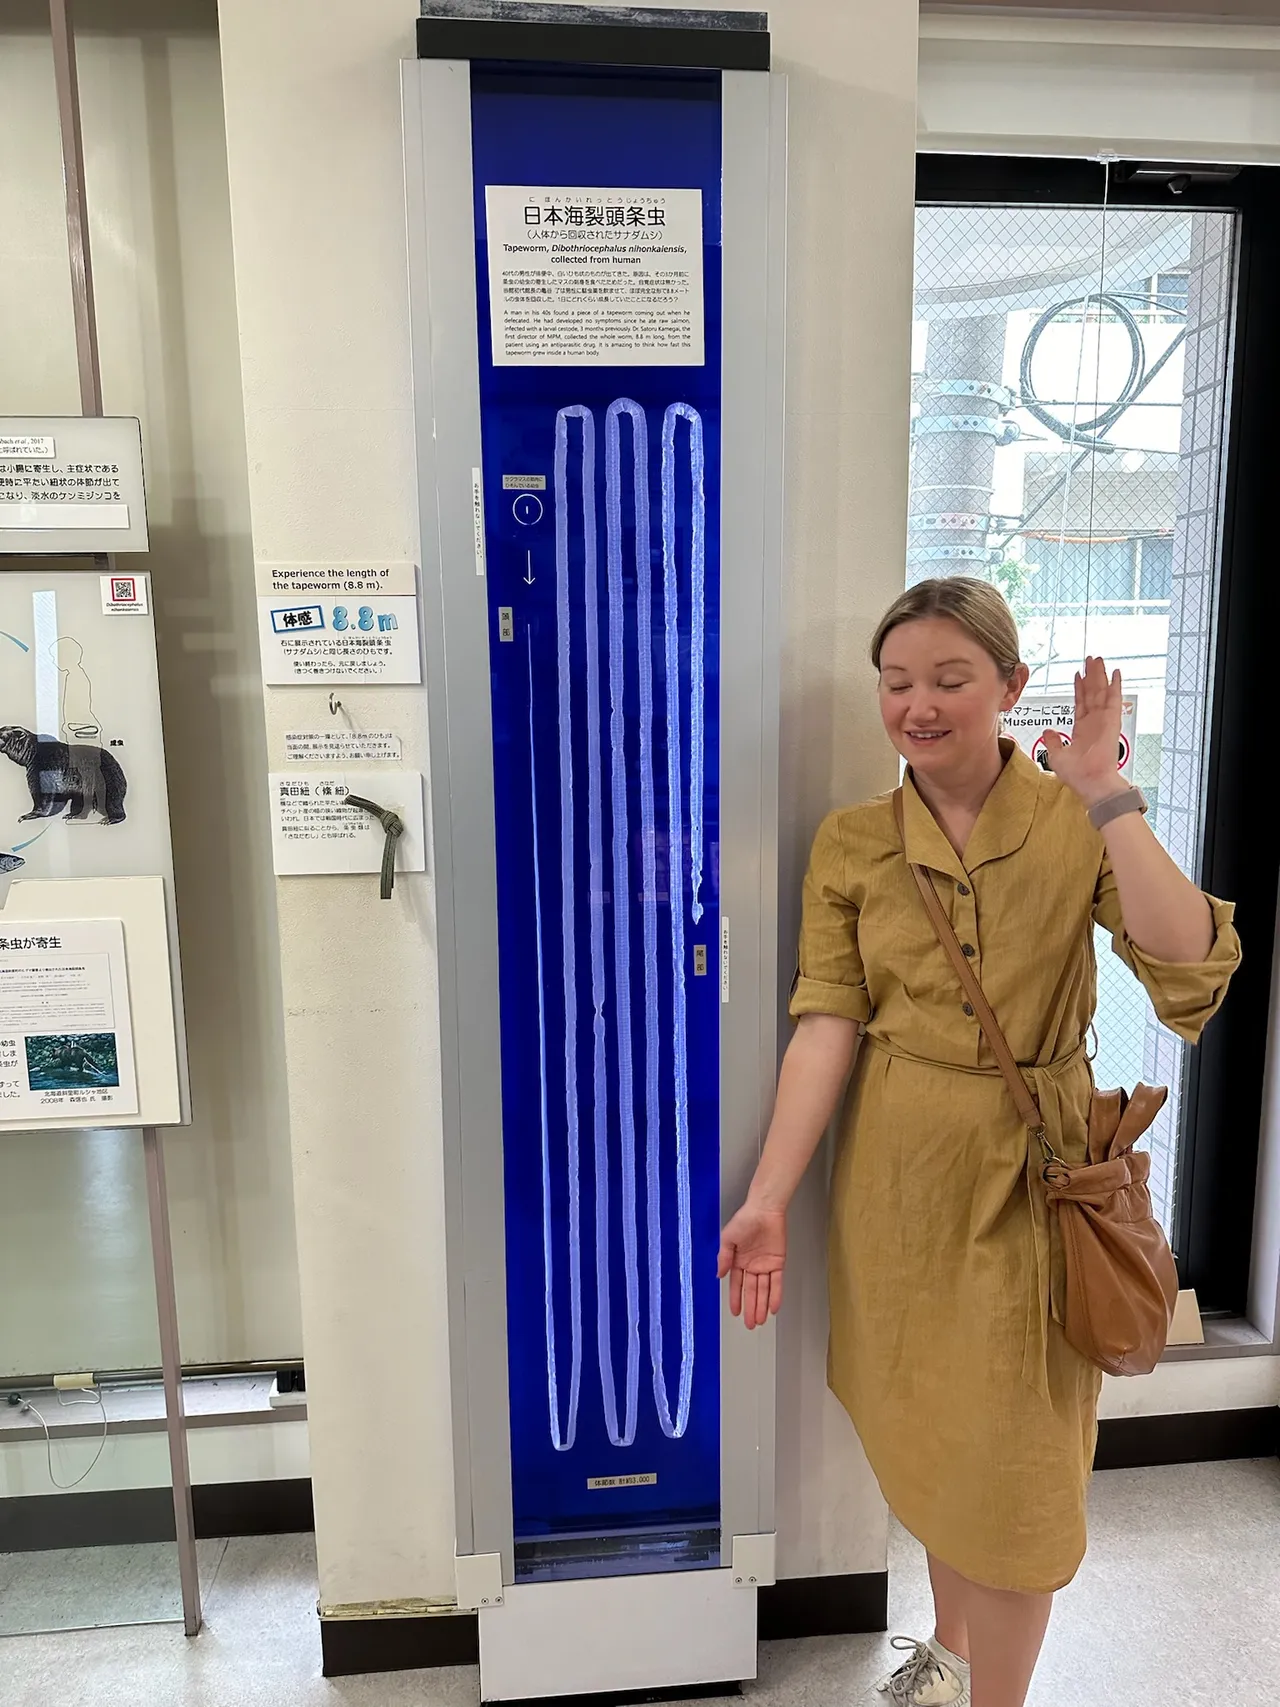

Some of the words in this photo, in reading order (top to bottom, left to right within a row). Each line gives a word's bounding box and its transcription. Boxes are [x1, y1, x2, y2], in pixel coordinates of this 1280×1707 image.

[524, 205, 666, 227] 日本海裂頭条虫
[503, 244, 550, 253] Tapeworm,
[551, 244, 627, 253] Dibothriocephalus
[628, 245, 688, 254] nihonkaiensis,
[272, 569, 325, 579] Experience
[328, 569, 344, 577] the
[346, 569, 377, 578] length
[380, 569, 389, 577] of
[273, 582, 289, 590] the
[292, 582, 340, 591] tapeworm
[343, 581, 363, 591] (8.8
[366, 581, 383, 590] m).
[283, 610, 313, 628] 体感
[332, 606, 398, 632] 8.8m
[1004, 718, 1052, 726] Museum
[0, 936, 62, 950] 条虫が寄生
